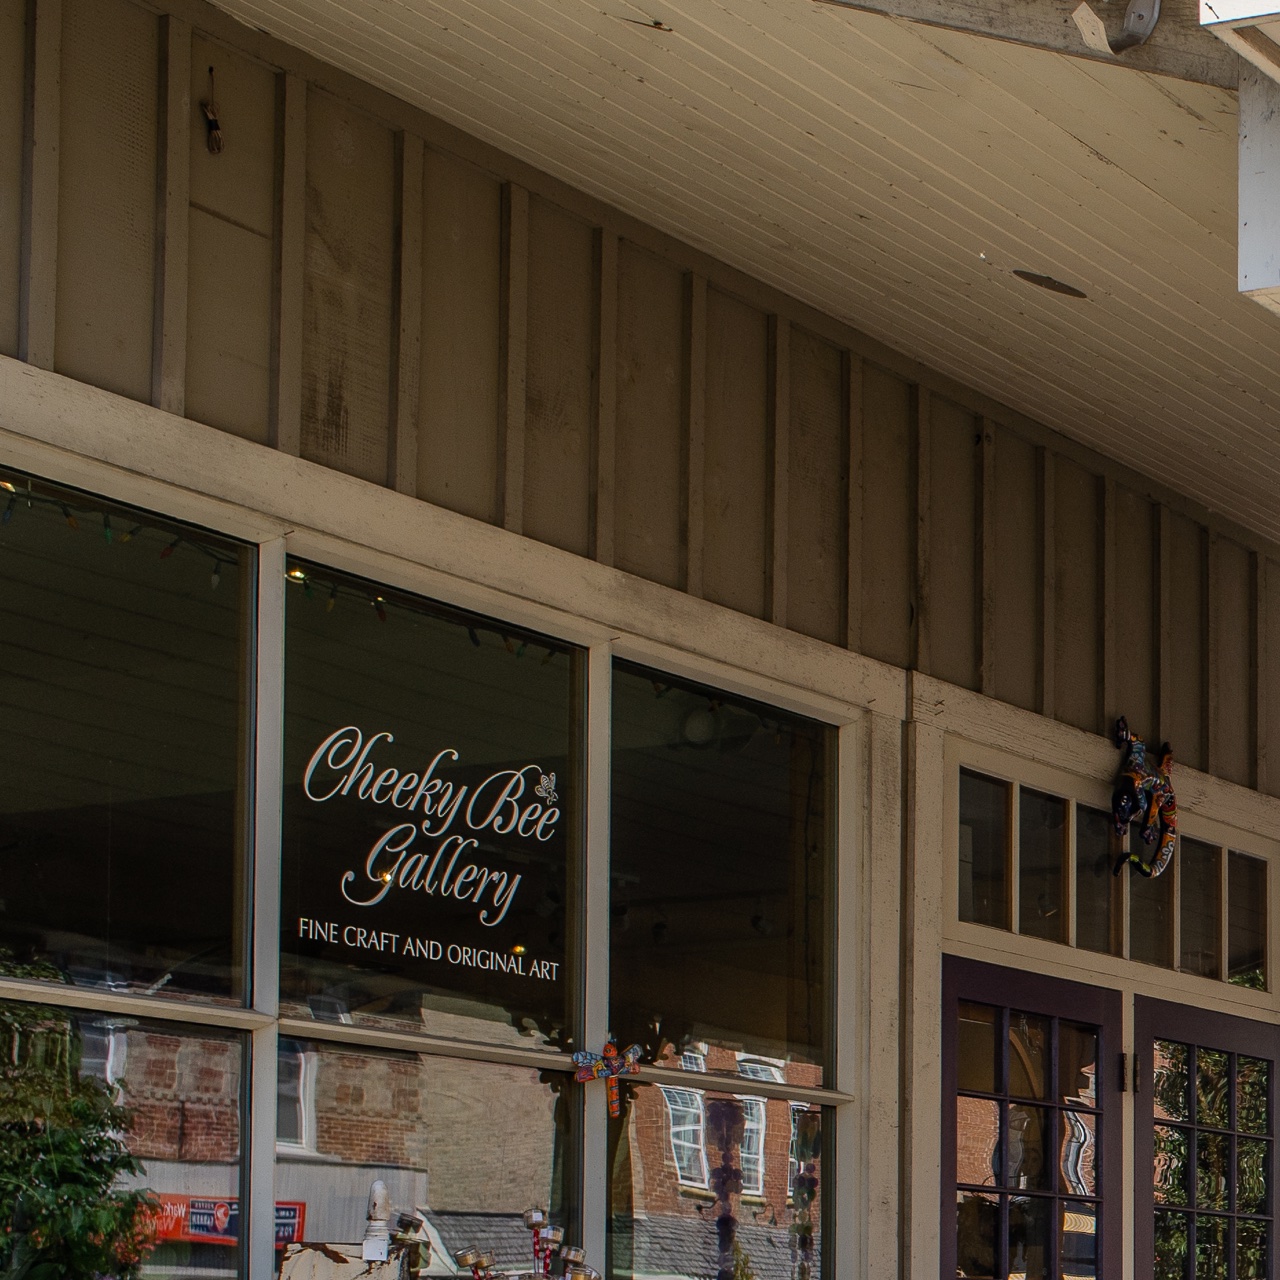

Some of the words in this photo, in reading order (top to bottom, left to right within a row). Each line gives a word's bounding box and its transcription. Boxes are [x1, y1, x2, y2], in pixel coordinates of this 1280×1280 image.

[304, 726, 468, 836] Cheeky
[466, 765, 560, 841] Bee
[341, 823, 522, 926] Gallery
[298, 917, 339, 944] FINE
[343, 925, 400, 953] CRAFT
[402, 936, 442, 961] AND
[447, 944, 526, 976] ORIGINAL
[529, 959, 560, 981] ART
